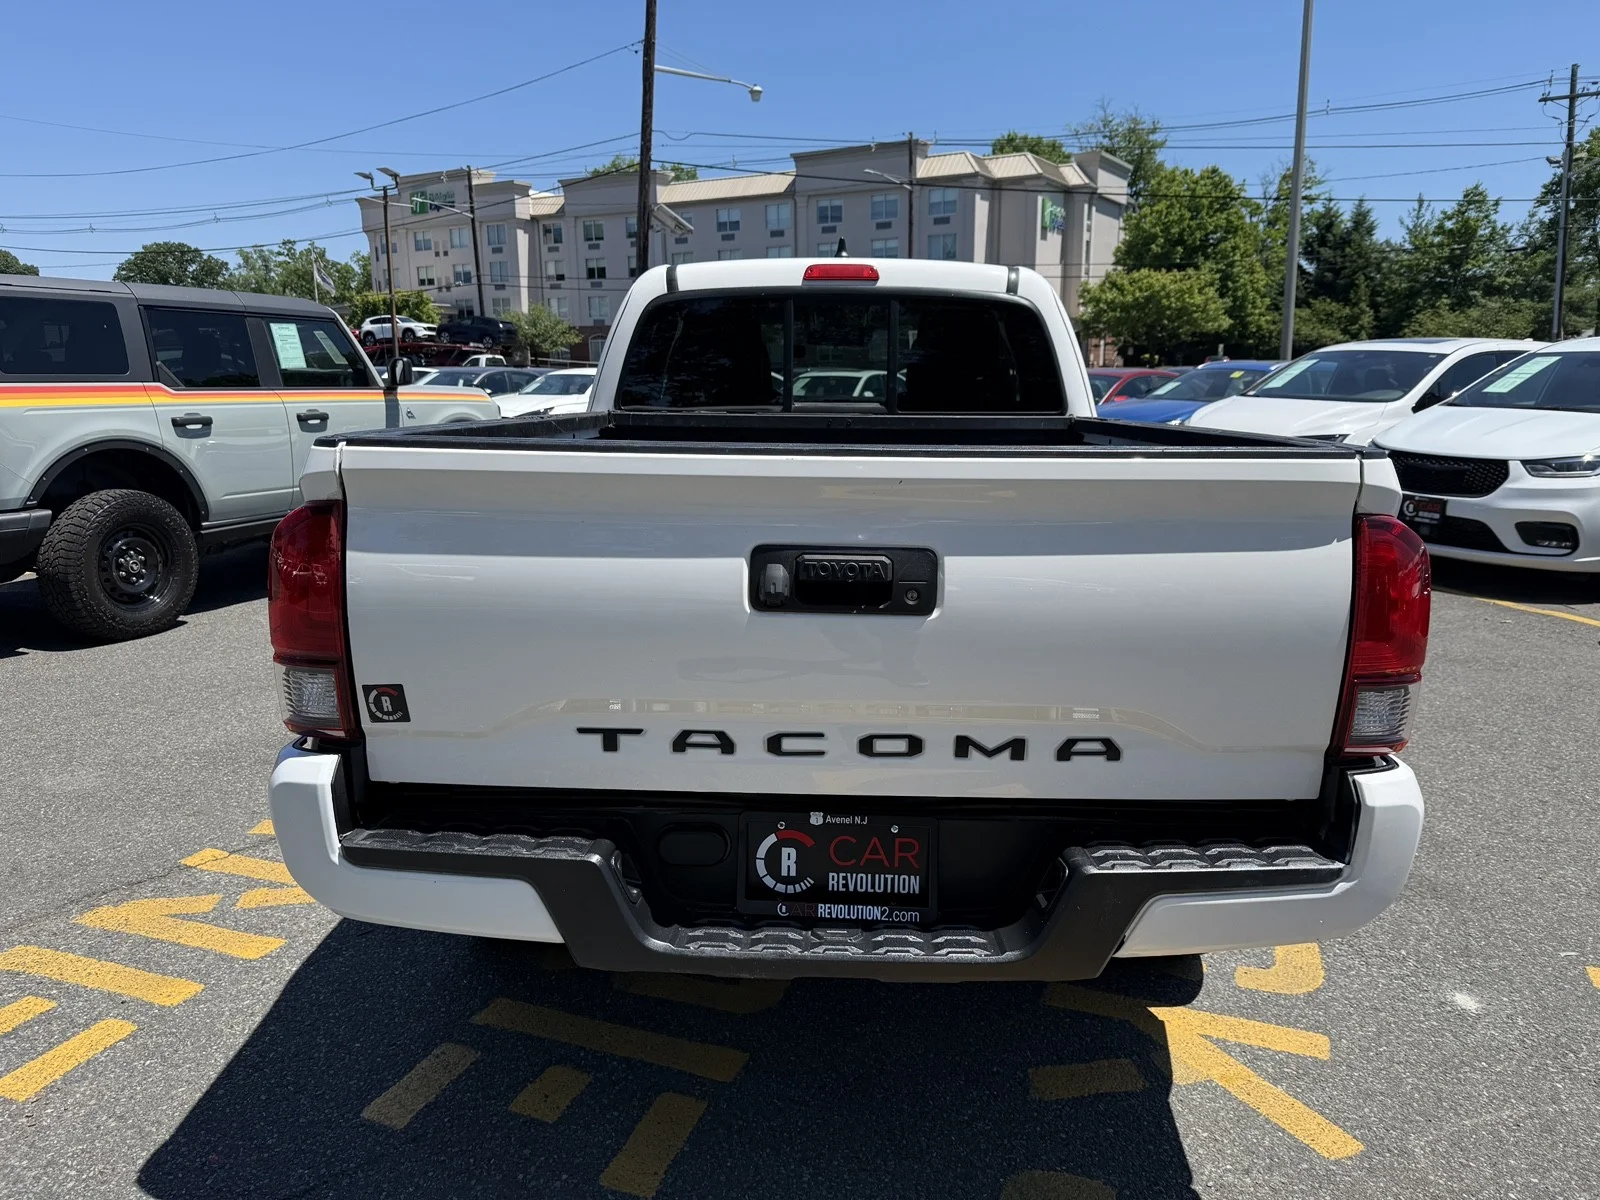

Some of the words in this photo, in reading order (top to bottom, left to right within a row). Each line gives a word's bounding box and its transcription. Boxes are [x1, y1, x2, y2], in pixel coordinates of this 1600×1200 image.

[804, 561, 886, 579] TOYOTA
[576, 727, 1122, 762] TACOMA
[825, 814, 853, 824] Avenel
[829, 835, 920, 869] CAR
[828, 872, 920, 895] REVOLUTION
